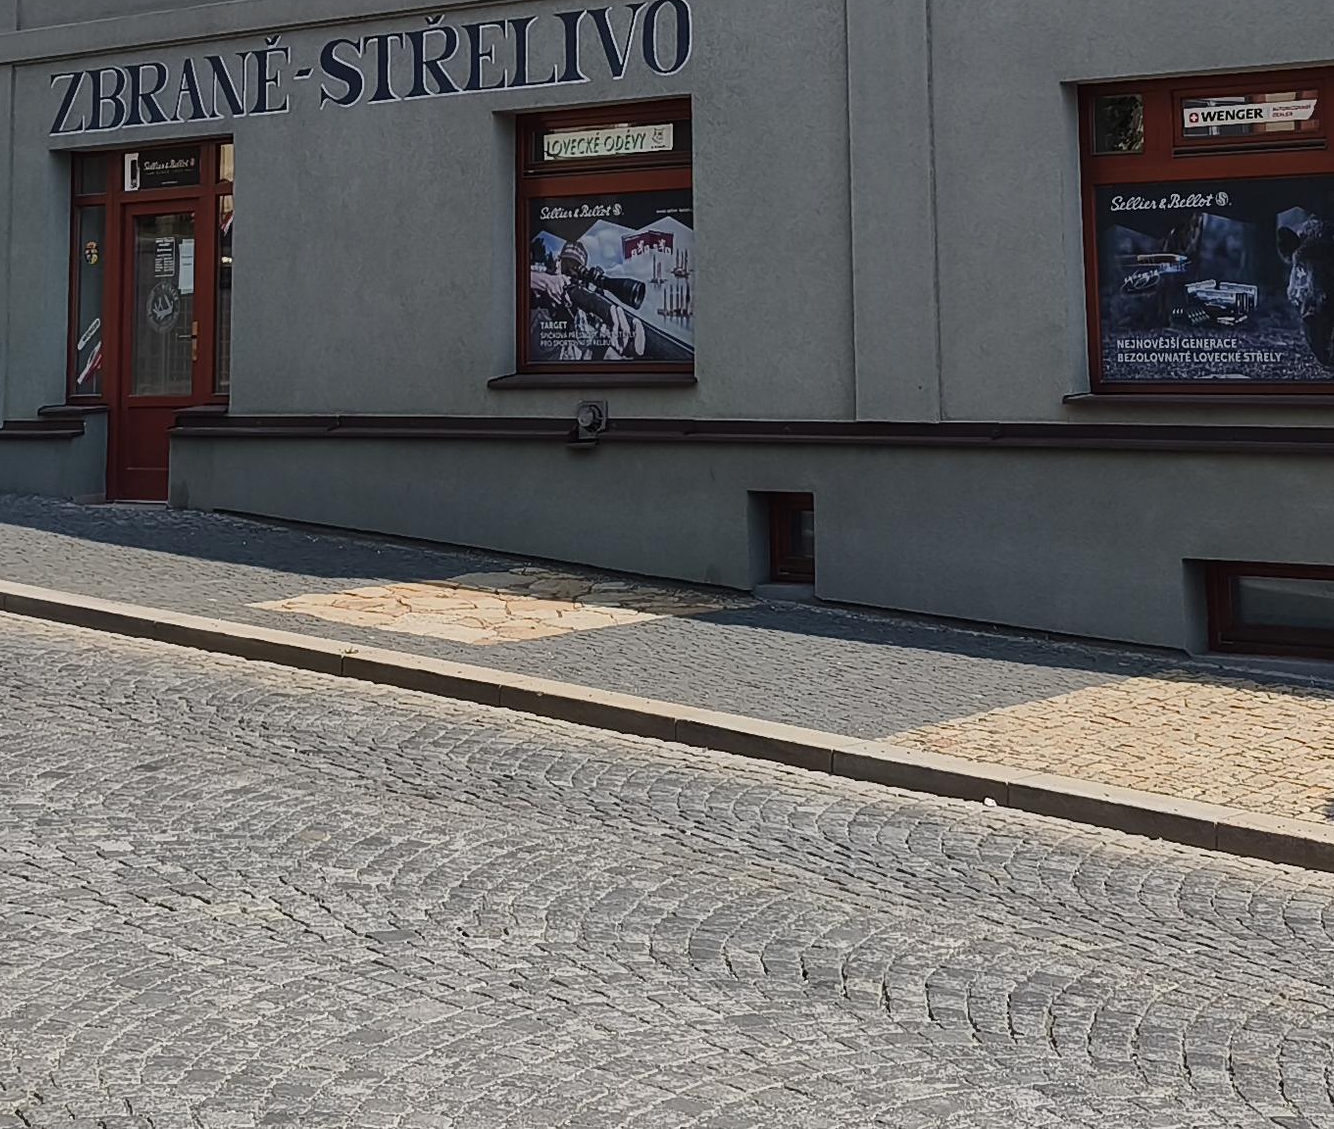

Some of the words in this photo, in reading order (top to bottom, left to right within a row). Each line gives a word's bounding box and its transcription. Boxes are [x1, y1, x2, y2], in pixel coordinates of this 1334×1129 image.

[1201, 108, 1264, 122] WENGER
[547, 132, 601, 156] LOVECKÉ
[1110, 196, 1157, 211] Sellier
[1159, 198, 1167, 210] &
[1168, 193, 1213, 208] Bellot
[539, 206, 572, 220] Sellier
[579, 204, 611, 218] Bellot
[540, 321, 568, 329] TARGET
[1117, 337, 1180, 349] NEJNOVĚJŠÍ
[1181, 338, 1238, 349] GENERACE
[1117, 351, 1191, 363] BEZOLOVNATÉ
[1193, 351, 1242, 363] LOVECKÉ
[1243, 350, 1283, 363] STŘELY
